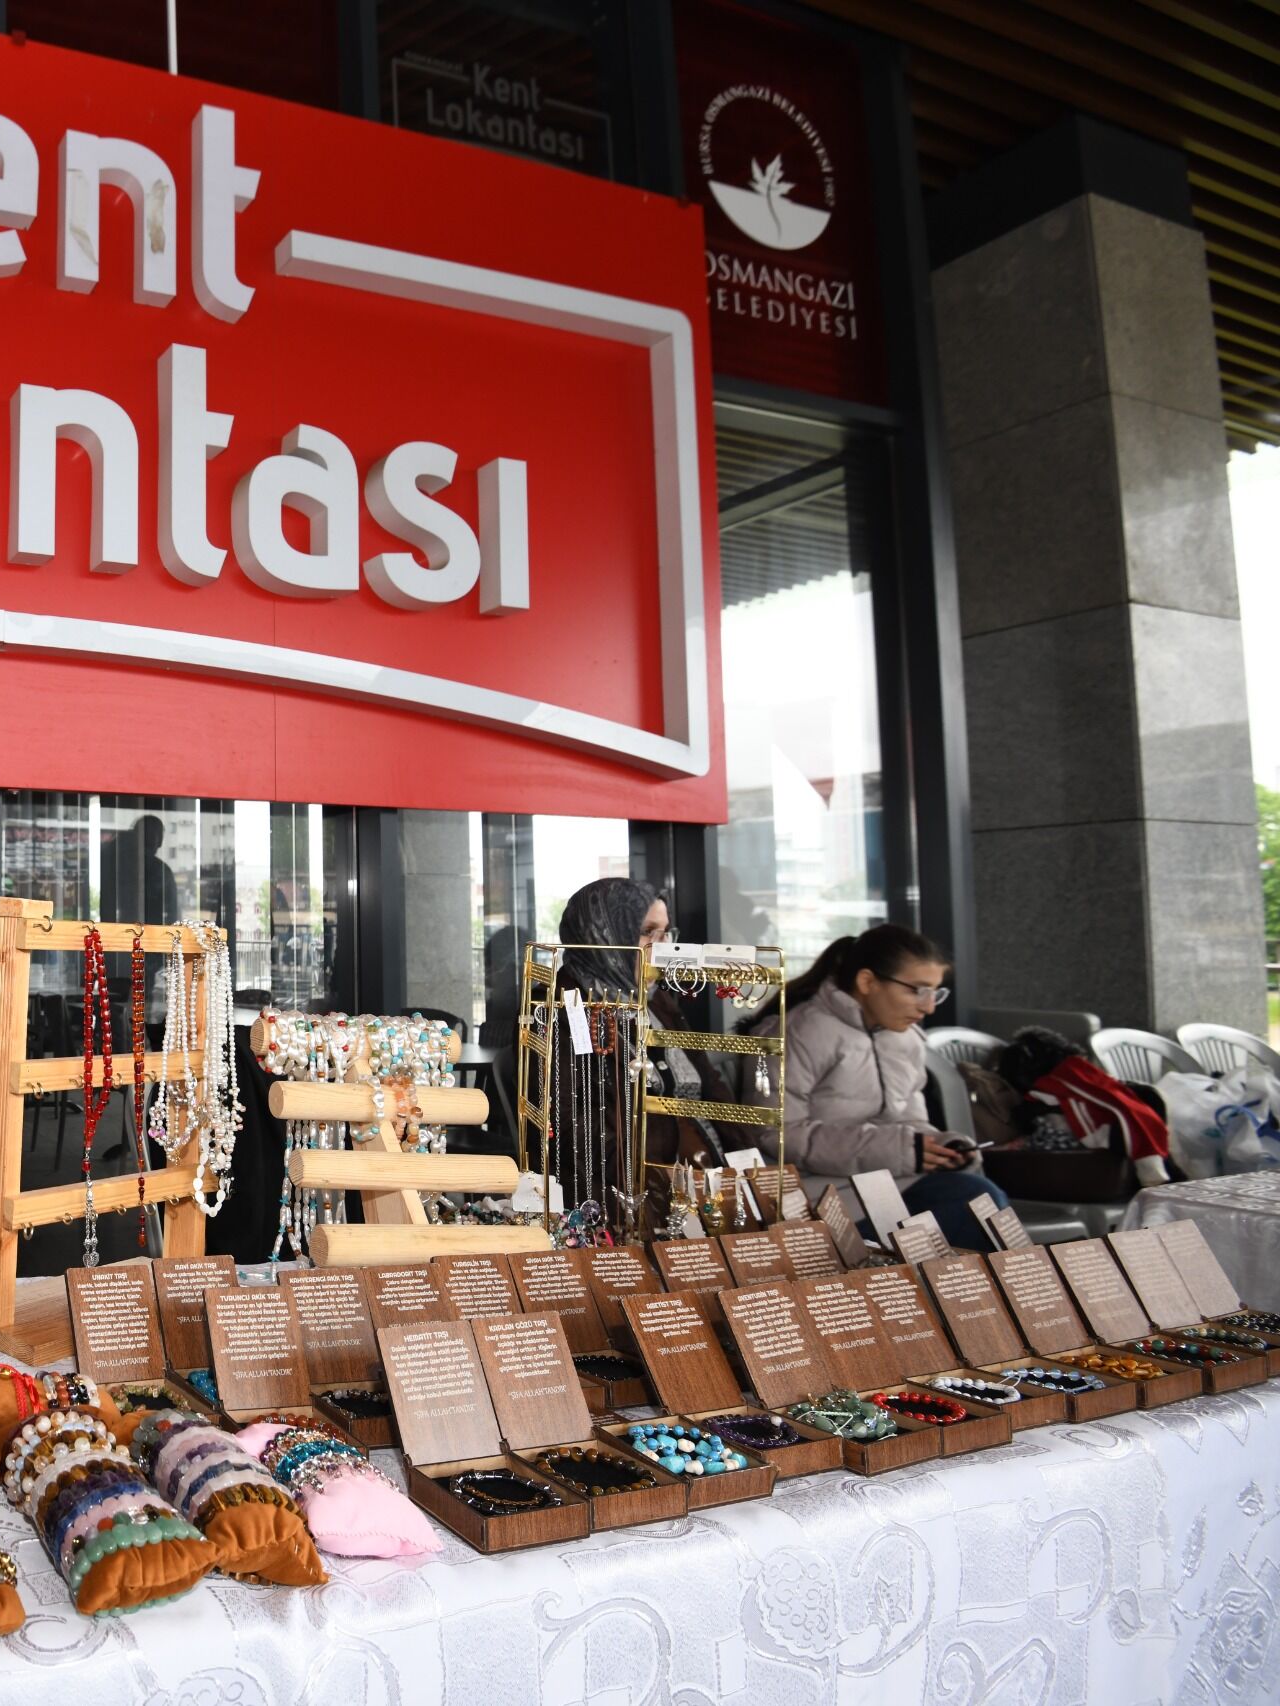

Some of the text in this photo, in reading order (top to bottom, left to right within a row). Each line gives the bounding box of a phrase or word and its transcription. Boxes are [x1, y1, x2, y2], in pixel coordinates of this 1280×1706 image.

[473, 62, 542, 111] Kent
[426, 88, 585, 162] Lokantası
[706, 287, 858, 340] ELEDİYESİ
